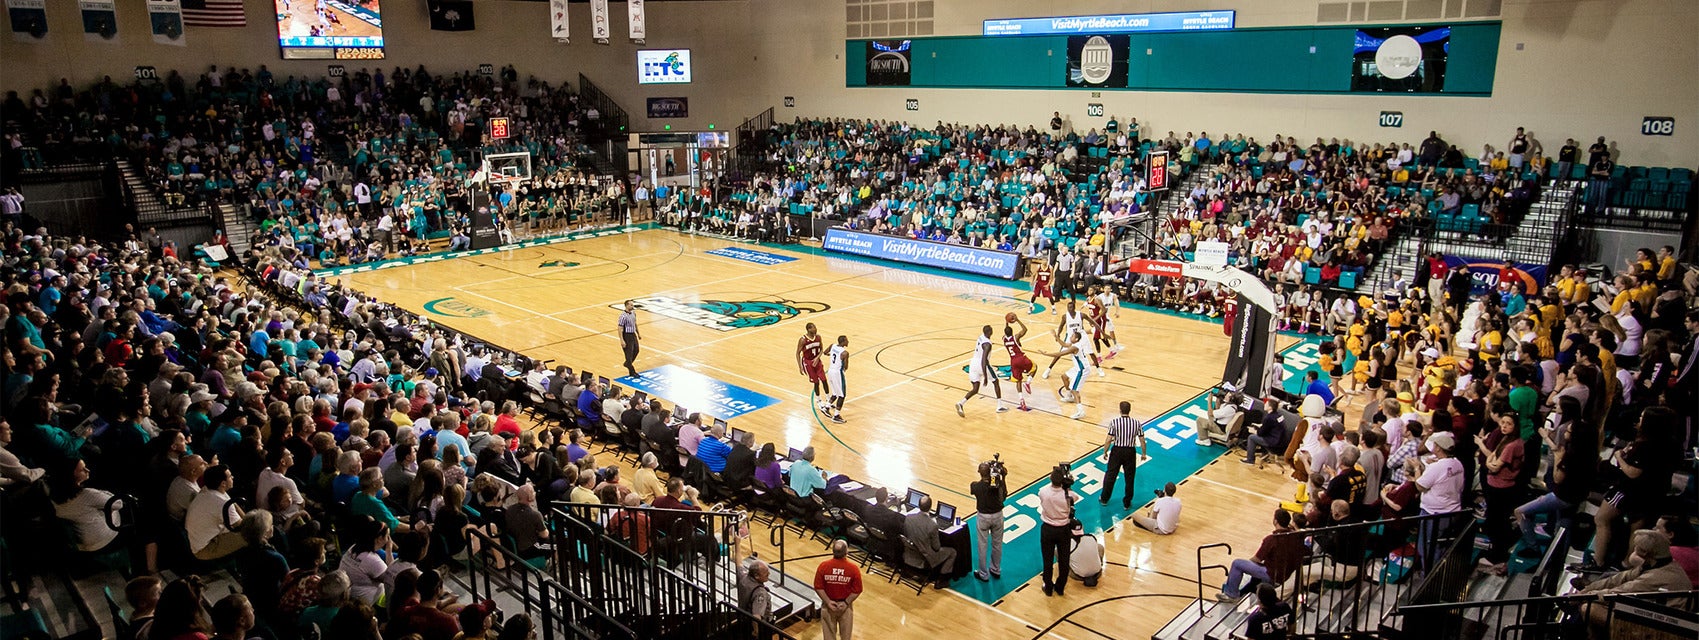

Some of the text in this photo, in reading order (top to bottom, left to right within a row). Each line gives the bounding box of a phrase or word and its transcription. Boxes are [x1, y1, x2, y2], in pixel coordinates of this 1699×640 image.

[1052, 18, 1149, 31] VisitMyrtleBeach.com
[136, 69, 157, 79] 101
[480, 66, 493, 74] 103
[1088, 105, 1103, 116] 106
[1380, 114, 1402, 125] 107
[493, 126, 505, 136] 28
[1643, 120, 1673, 134] 108
[1151, 167, 1163, 186] 28
[829, 236, 872, 249] MYRTLE BEACH
[882, 239, 1004, 269] VisitMyrtleBeach.com
[1008, 346, 1016, 356] 5
[832, 353, 837, 364] 3
